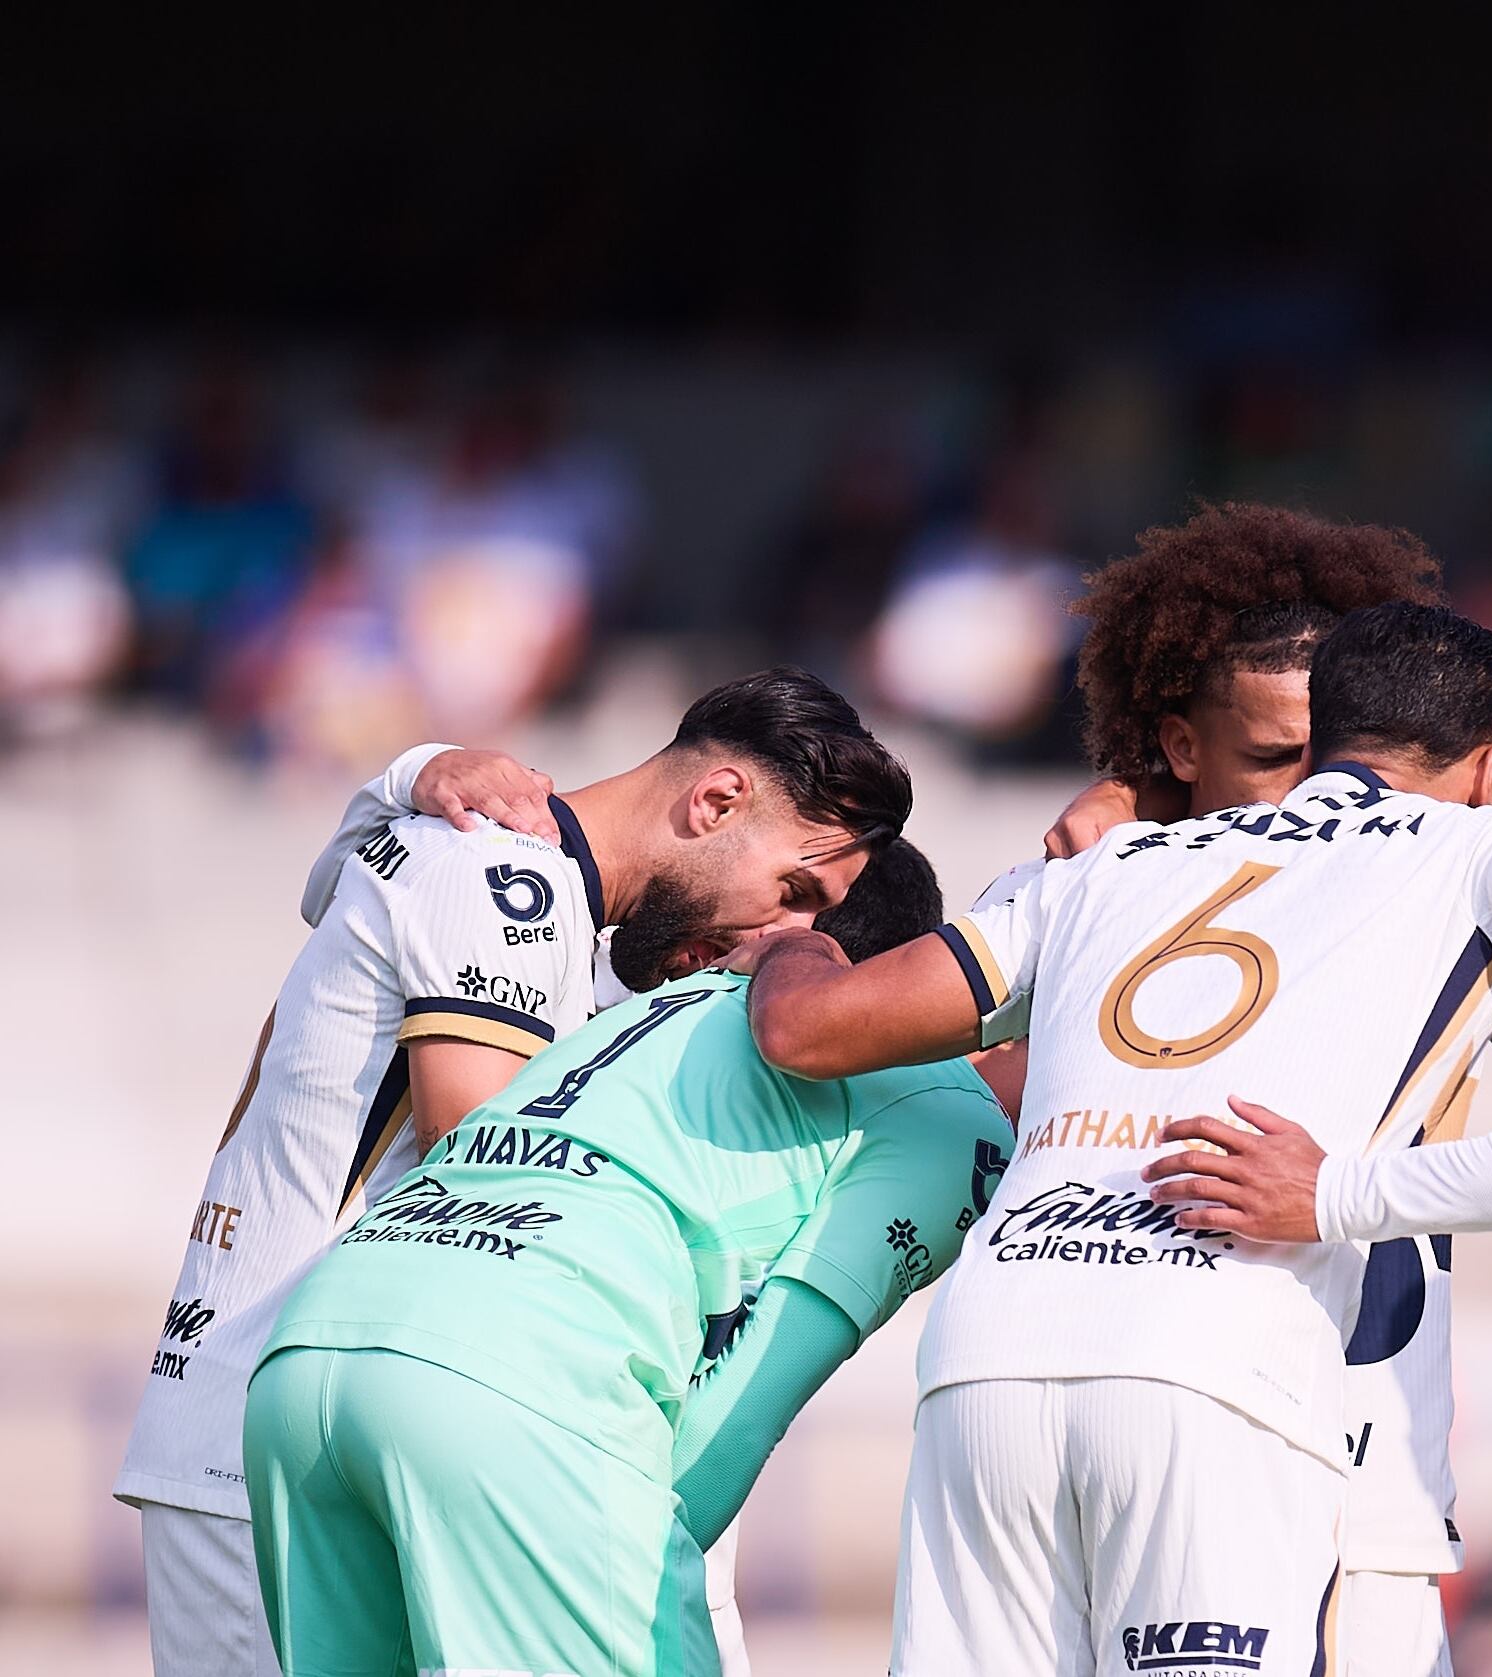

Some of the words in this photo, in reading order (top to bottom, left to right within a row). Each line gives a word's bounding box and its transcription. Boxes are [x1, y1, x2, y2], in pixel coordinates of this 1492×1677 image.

[1098, 860, 1284, 1070] 6
[490, 976, 547, 1015] GNP
[464, 1126, 610, 1177] NAVAS
[1016, 1109, 1172, 1165] NATHAN
